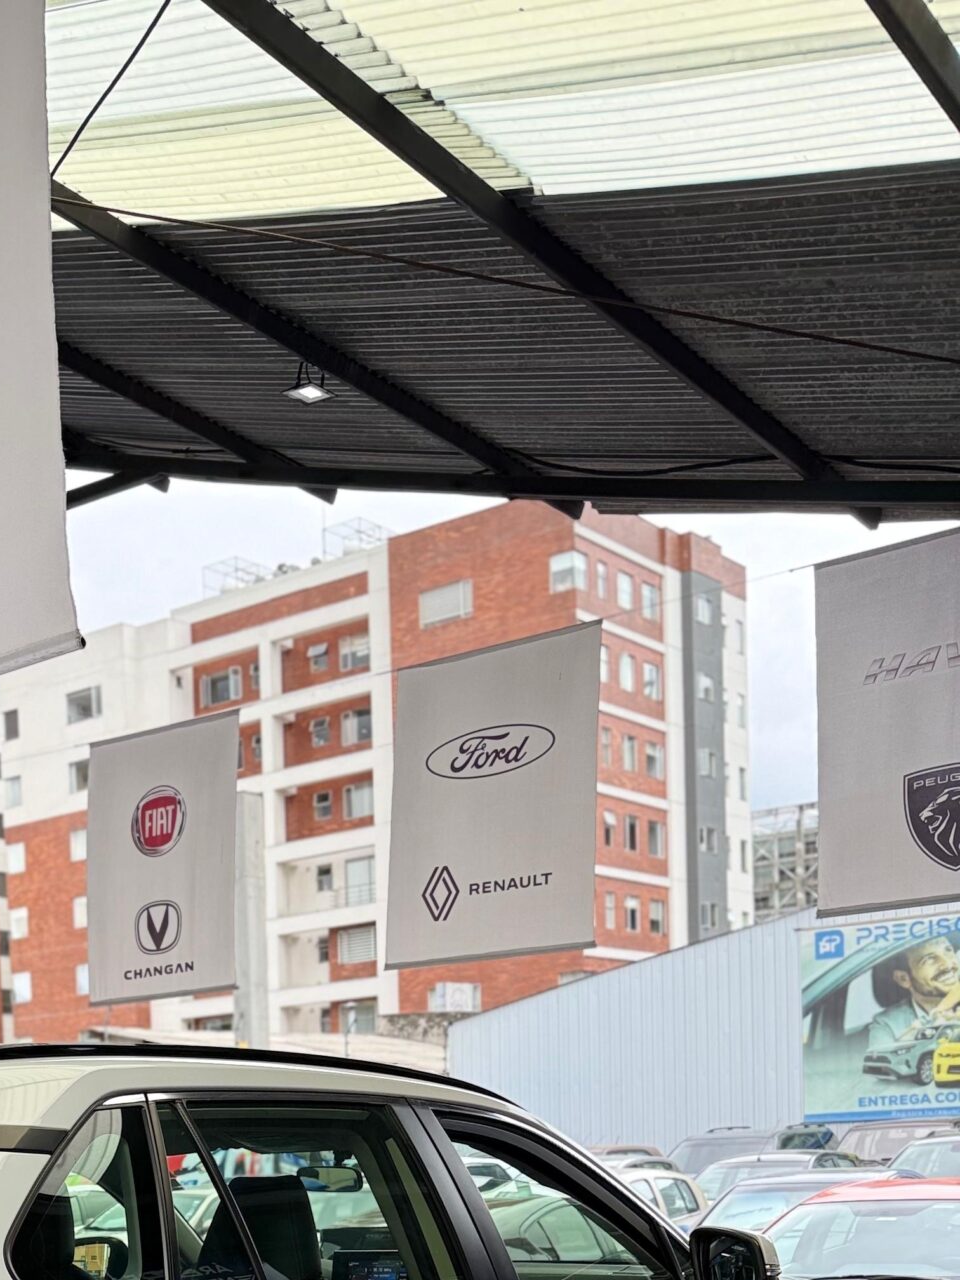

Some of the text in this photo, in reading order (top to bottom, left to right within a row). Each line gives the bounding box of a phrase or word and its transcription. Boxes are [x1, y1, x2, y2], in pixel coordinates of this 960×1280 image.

[449, 731, 530, 773] Ford
[144, 804, 176, 840] FIAT
[468, 871, 553, 897] RENAULT
[123, 960, 195, 981] CHANGAN
[858, 1091, 960, 1108] ENTREGA CO
